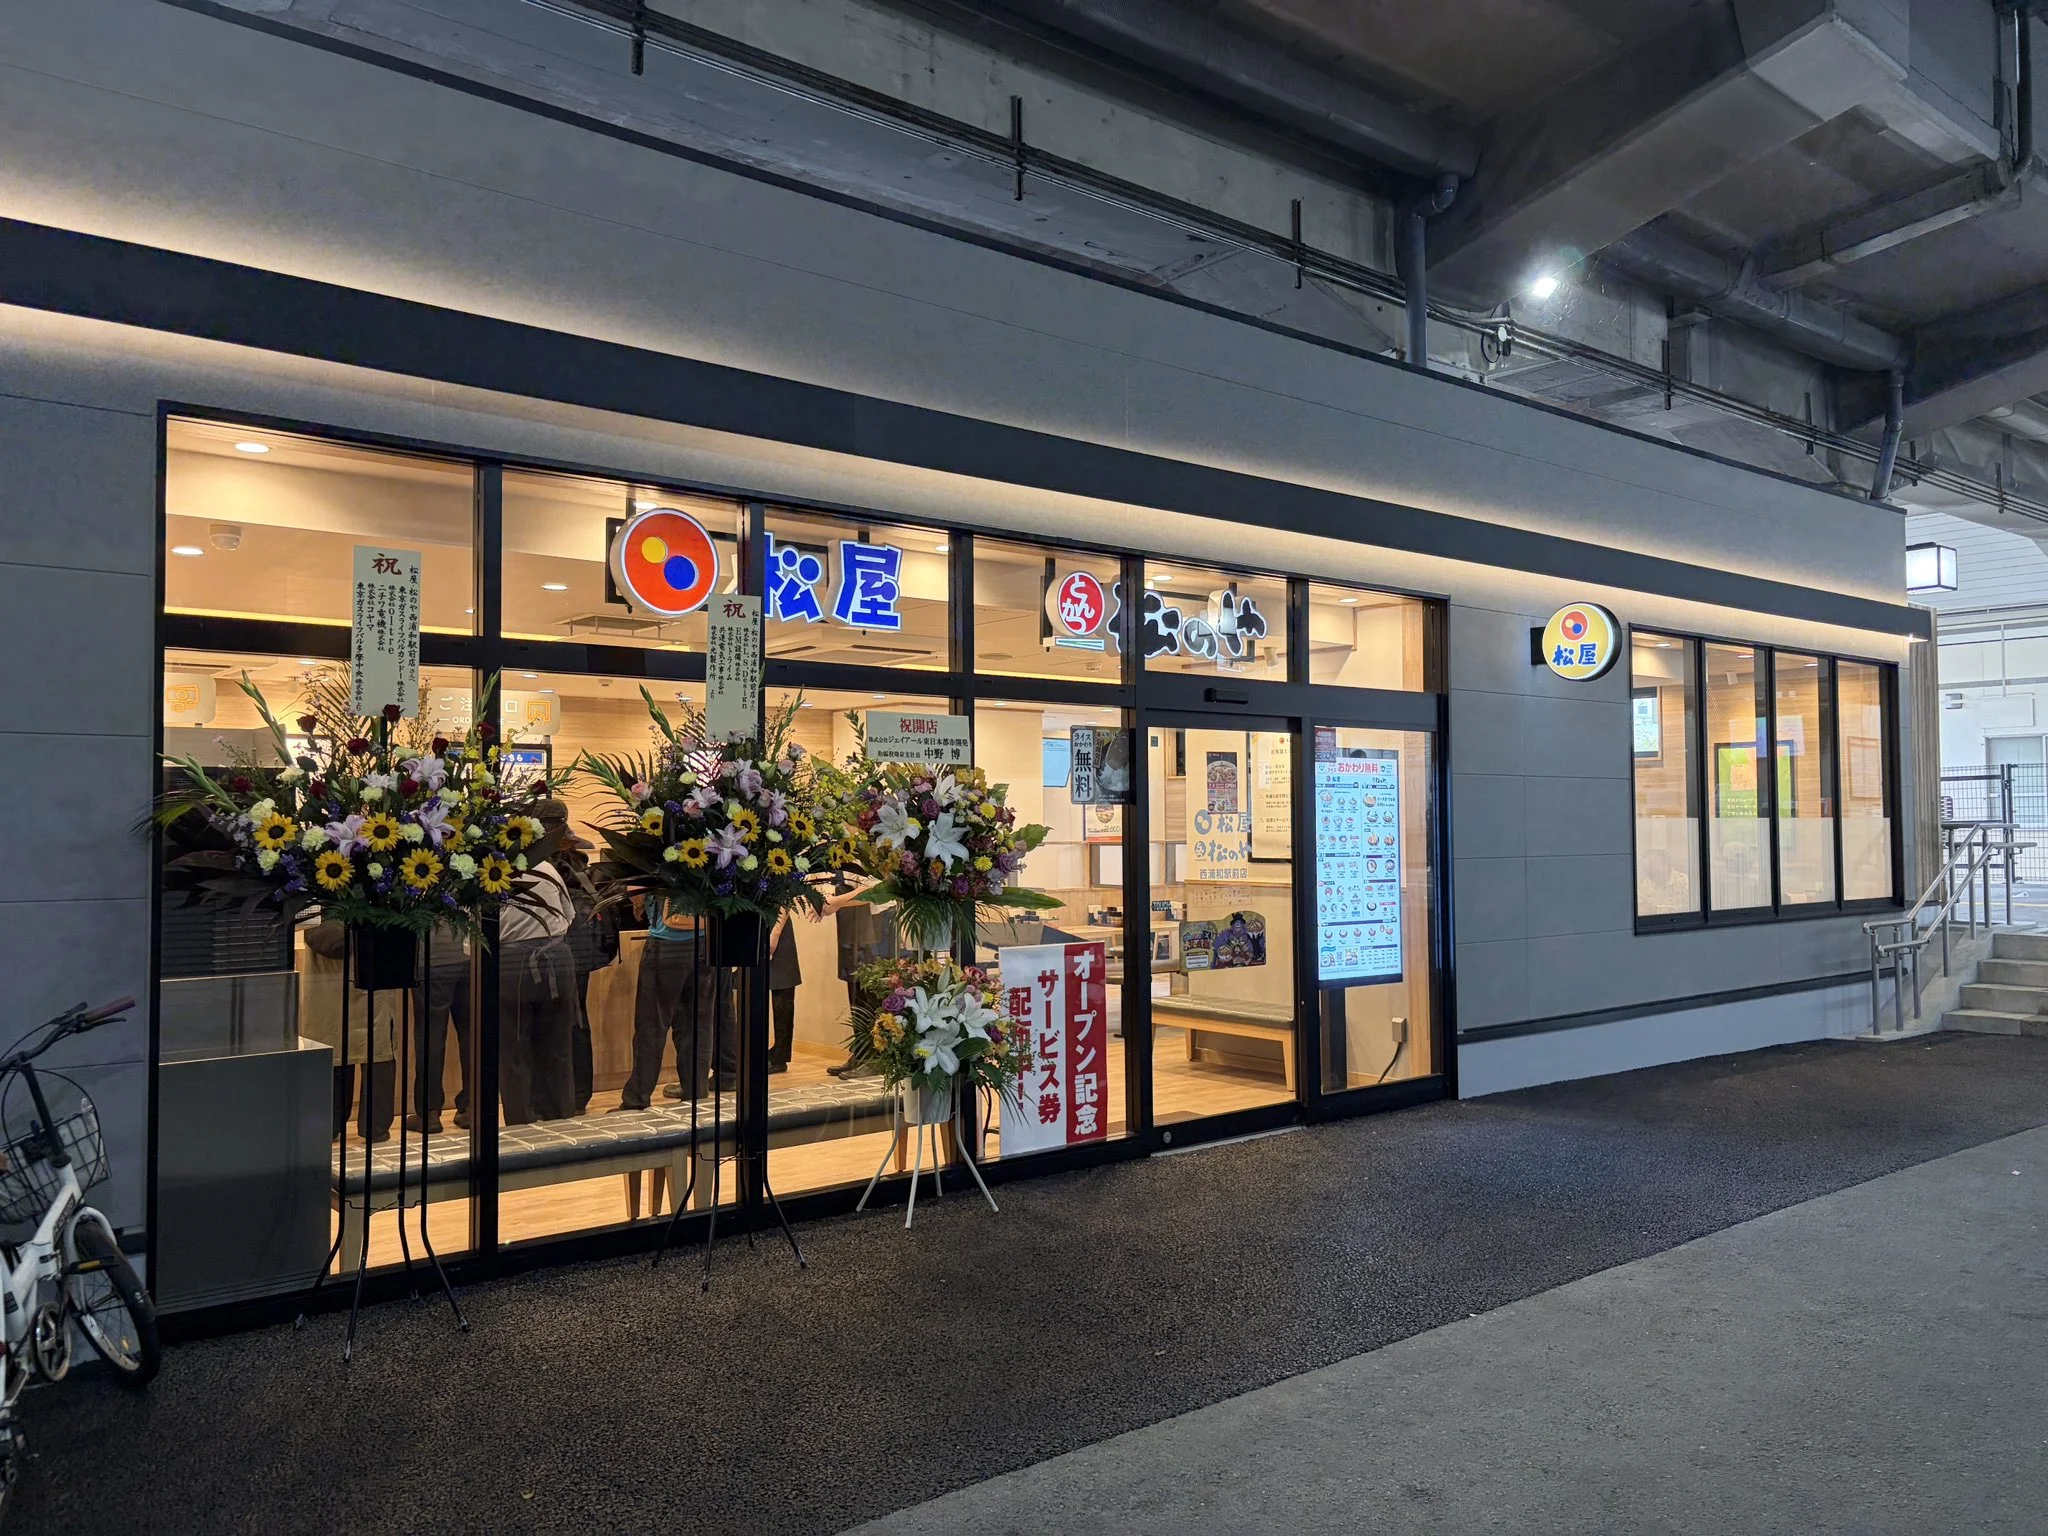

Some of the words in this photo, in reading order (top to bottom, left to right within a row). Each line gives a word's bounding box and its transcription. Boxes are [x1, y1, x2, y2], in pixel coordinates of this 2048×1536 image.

[372, 553, 402, 575] 祝
[764, 532, 903, 631] 松屋
[366, 583, 376, 631] 株式会社コヤマ
[377, 584, 387, 651] ニチワ電機株式会社
[723, 599, 746, 618] 祝
[1552, 643, 1597, 666] 松屋
[900, 718, 938, 734] 祝開店
[1074, 732, 1091, 741] ライス
[924, 747, 944, 759] 中野
[1074, 749, 1092, 798] 無料
[1208, 840, 1252, 862] 松のや
[1038, 969, 1061, 1124] サービス券
[1074, 950, 1099, 1135] オープン記念
